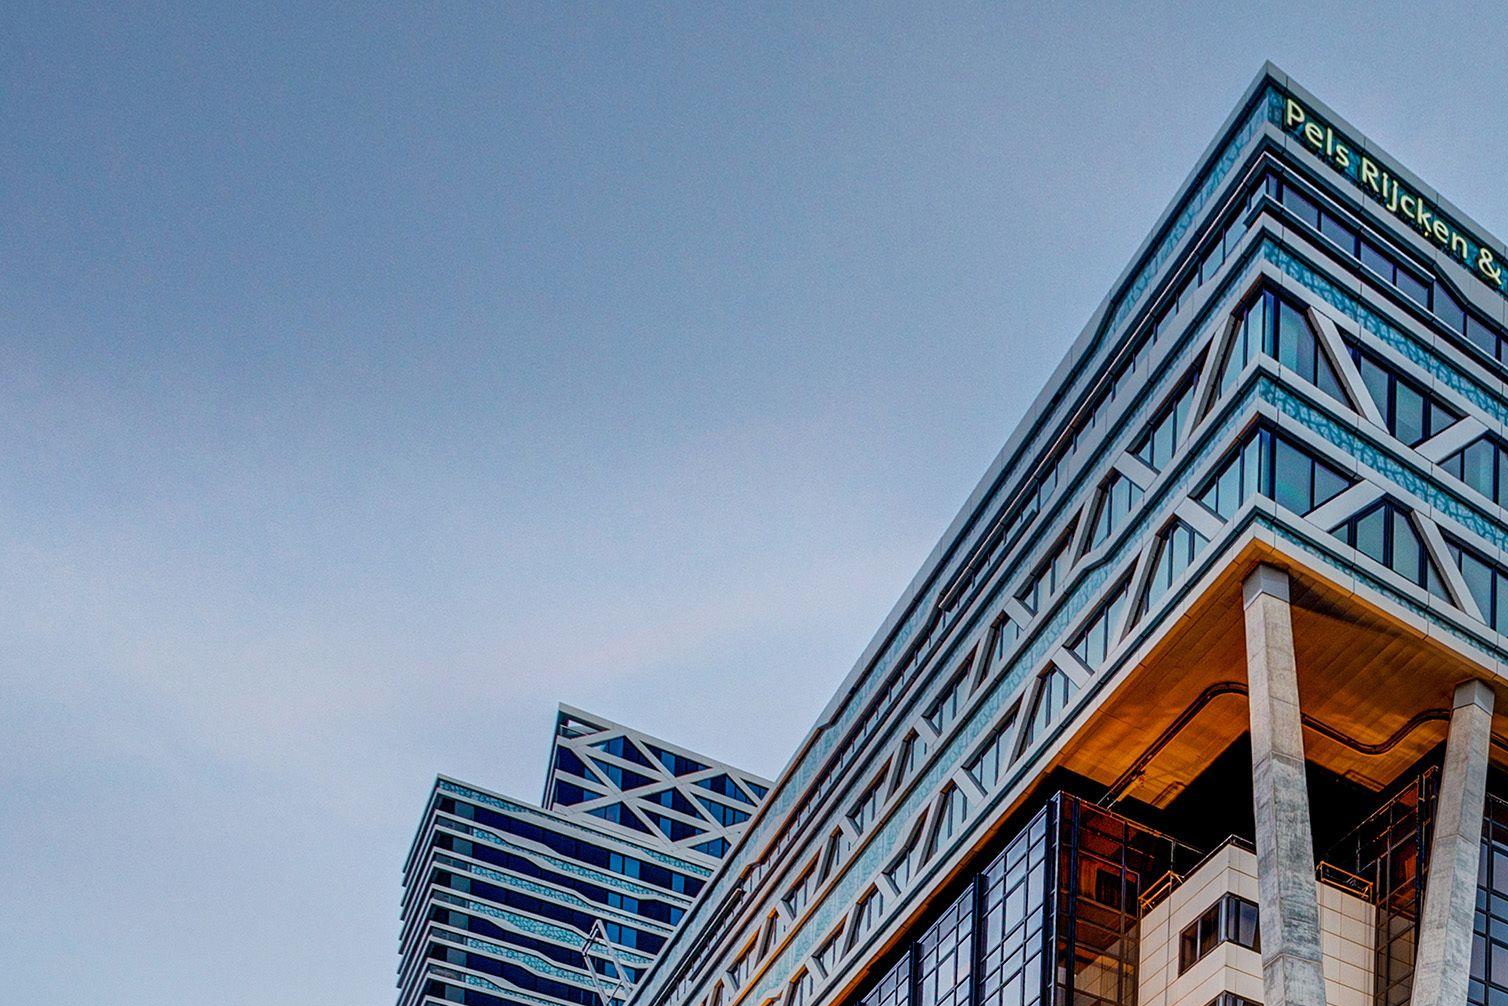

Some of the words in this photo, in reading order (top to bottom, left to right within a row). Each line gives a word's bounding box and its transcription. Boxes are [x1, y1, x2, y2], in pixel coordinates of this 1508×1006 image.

[1286, 98, 1350, 168] Pels
[1361, 156, 1468, 258] Rijcken
[1477, 246, 1502, 286] &
